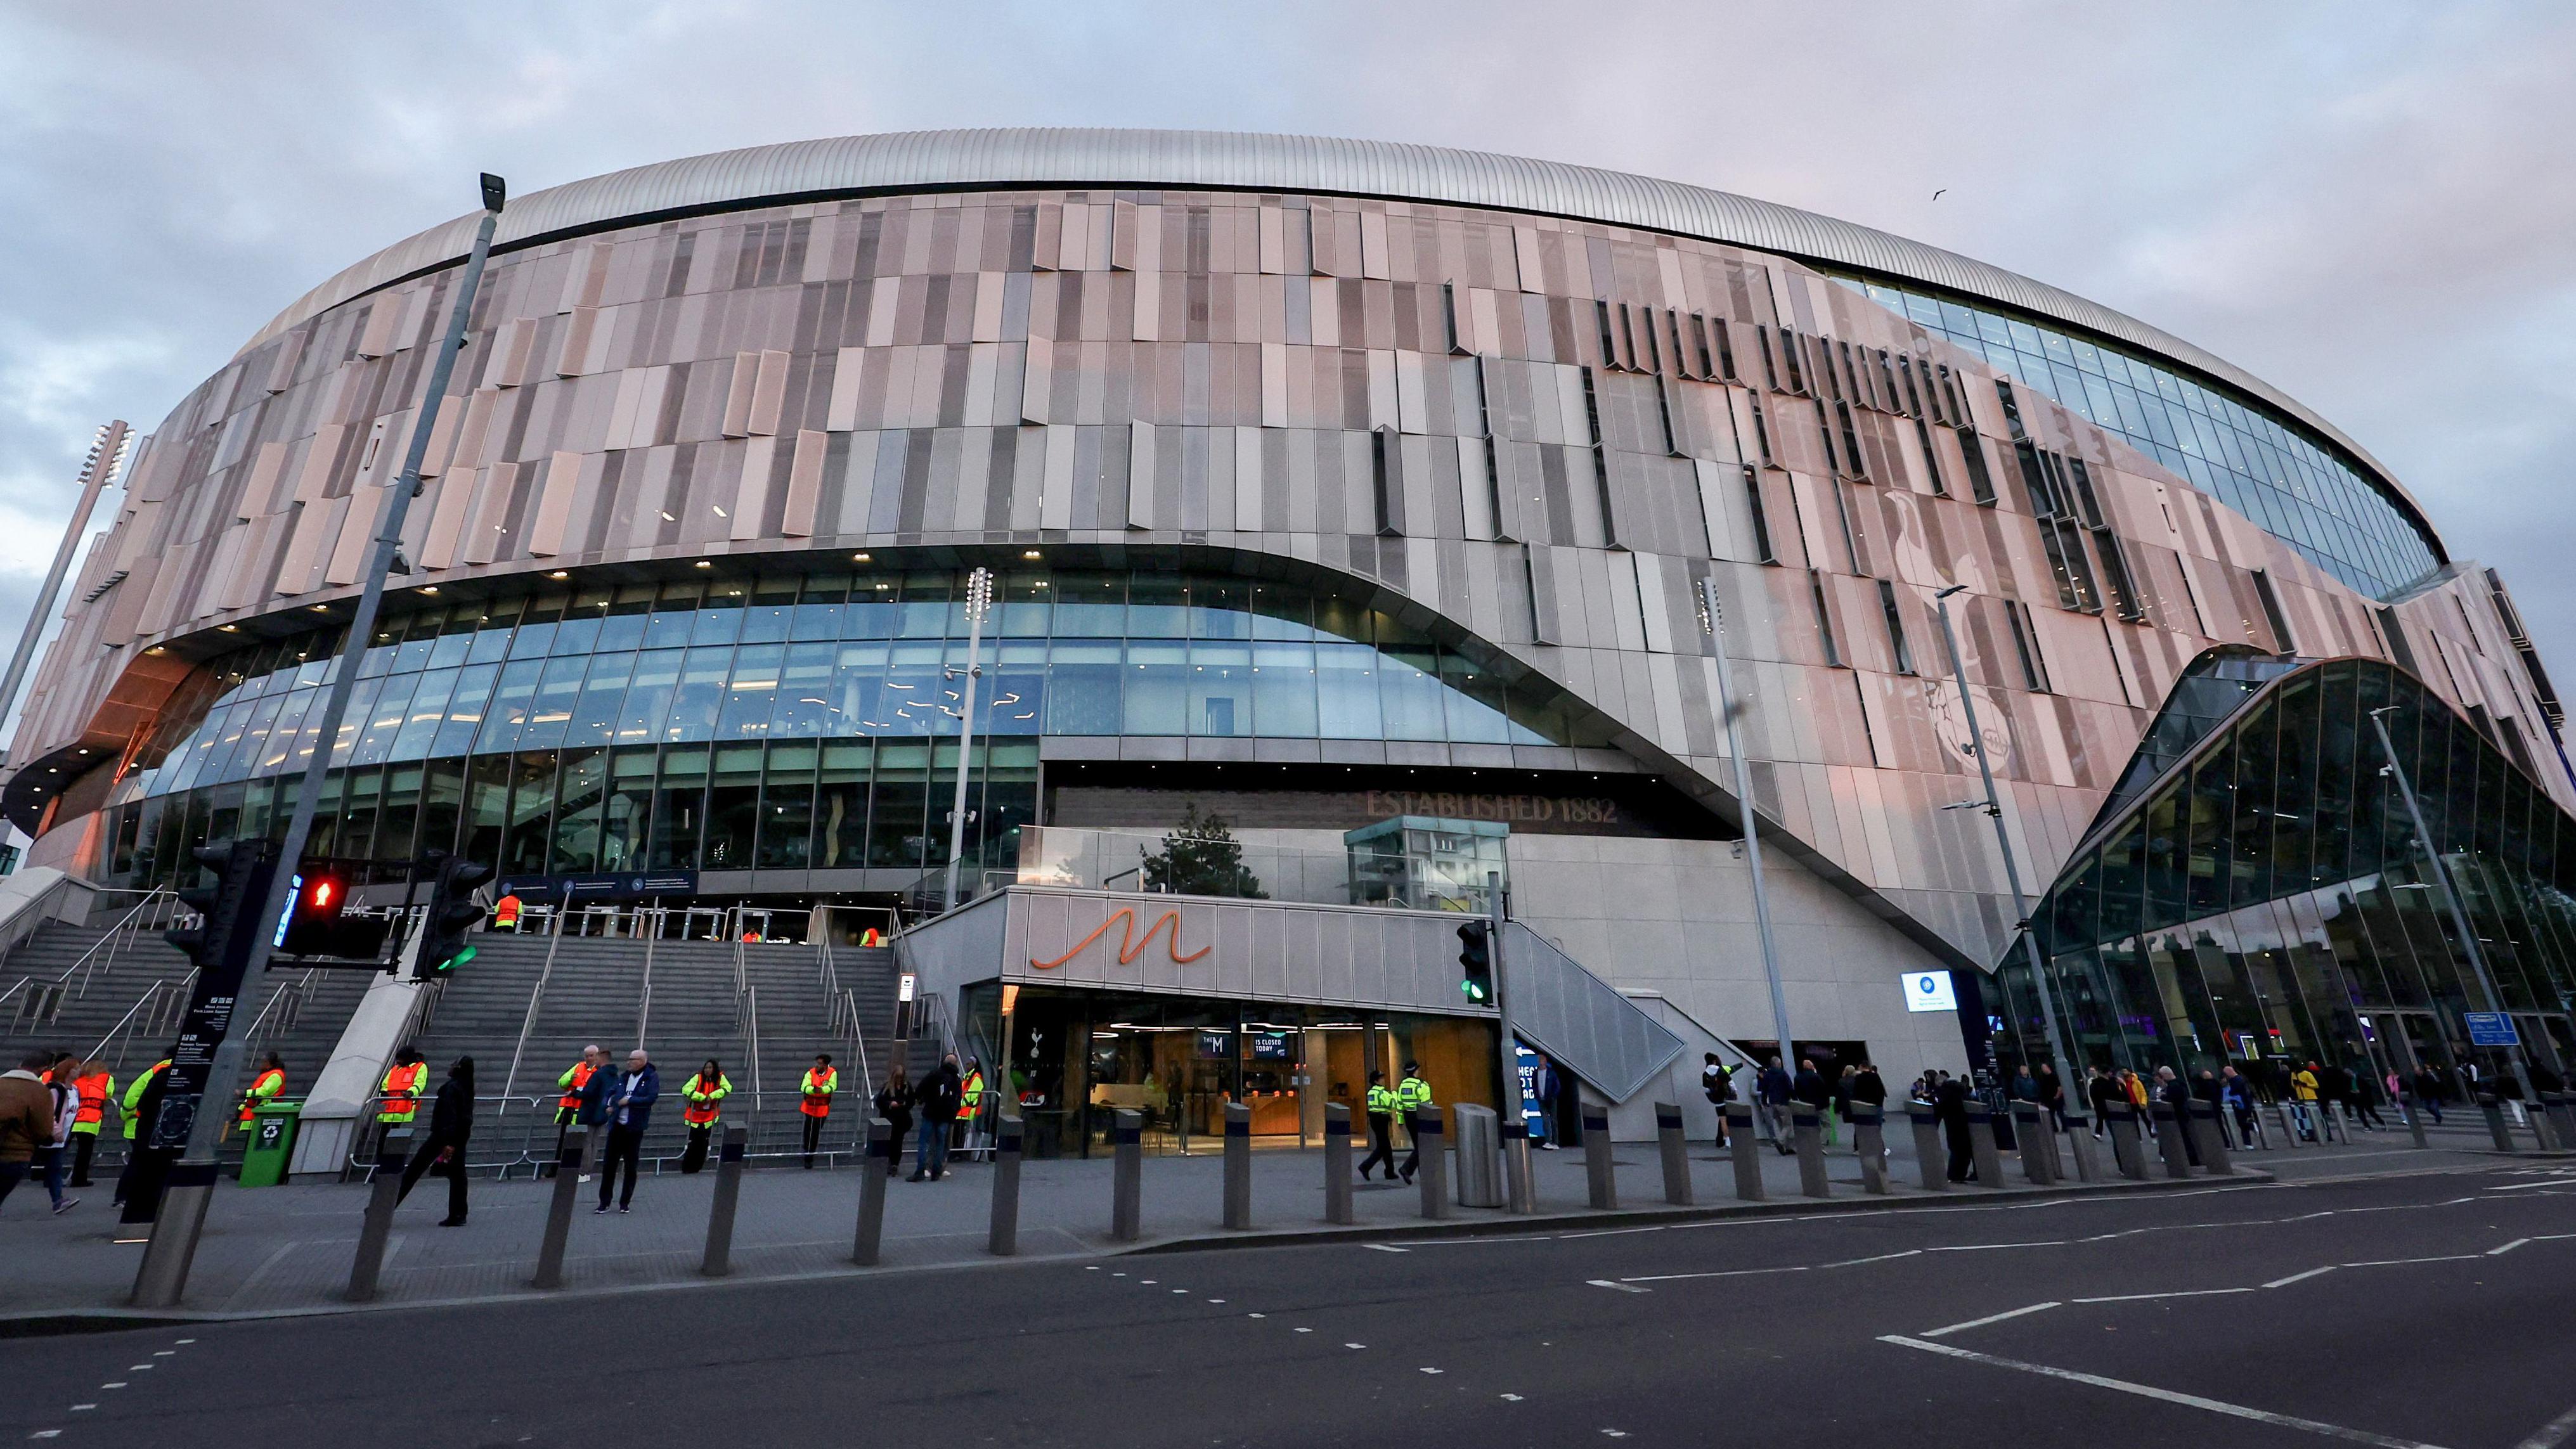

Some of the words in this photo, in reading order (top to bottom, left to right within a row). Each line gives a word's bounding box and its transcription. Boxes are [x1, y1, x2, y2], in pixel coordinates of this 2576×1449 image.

[1367, 790, 1553, 821] ESTABLISHED
[1558, 796, 1617, 823] 1882
[1212, 1036, 1223, 1053] M
